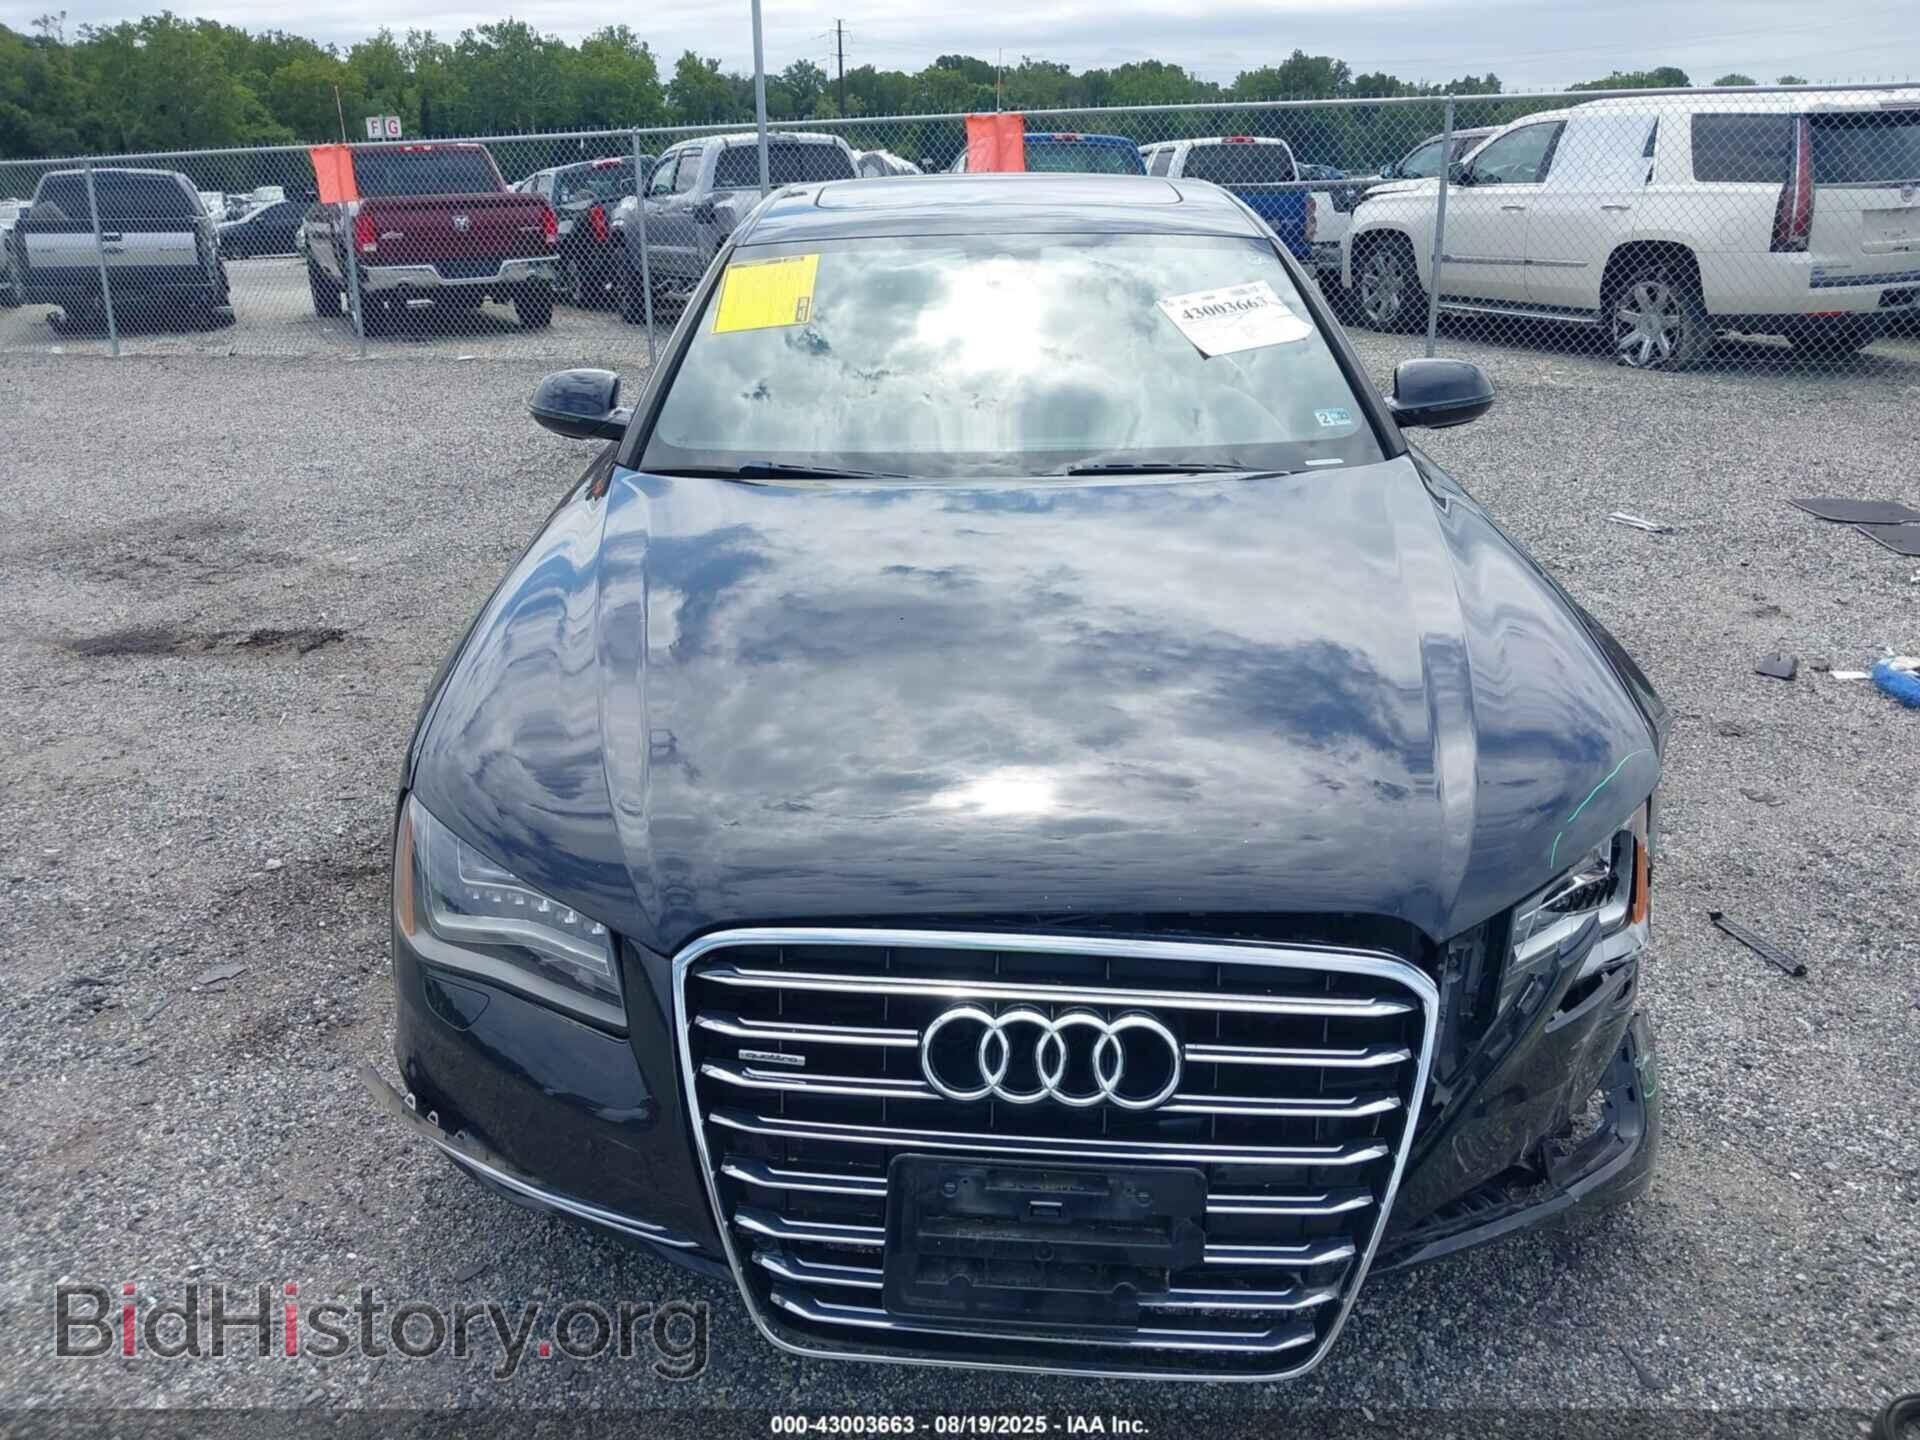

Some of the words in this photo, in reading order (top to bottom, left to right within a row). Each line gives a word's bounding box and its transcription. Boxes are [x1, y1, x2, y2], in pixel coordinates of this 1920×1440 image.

[371, 120, 379, 134] F
[388, 120, 399, 134] G
[1182, 296, 1267, 321] 43003663
